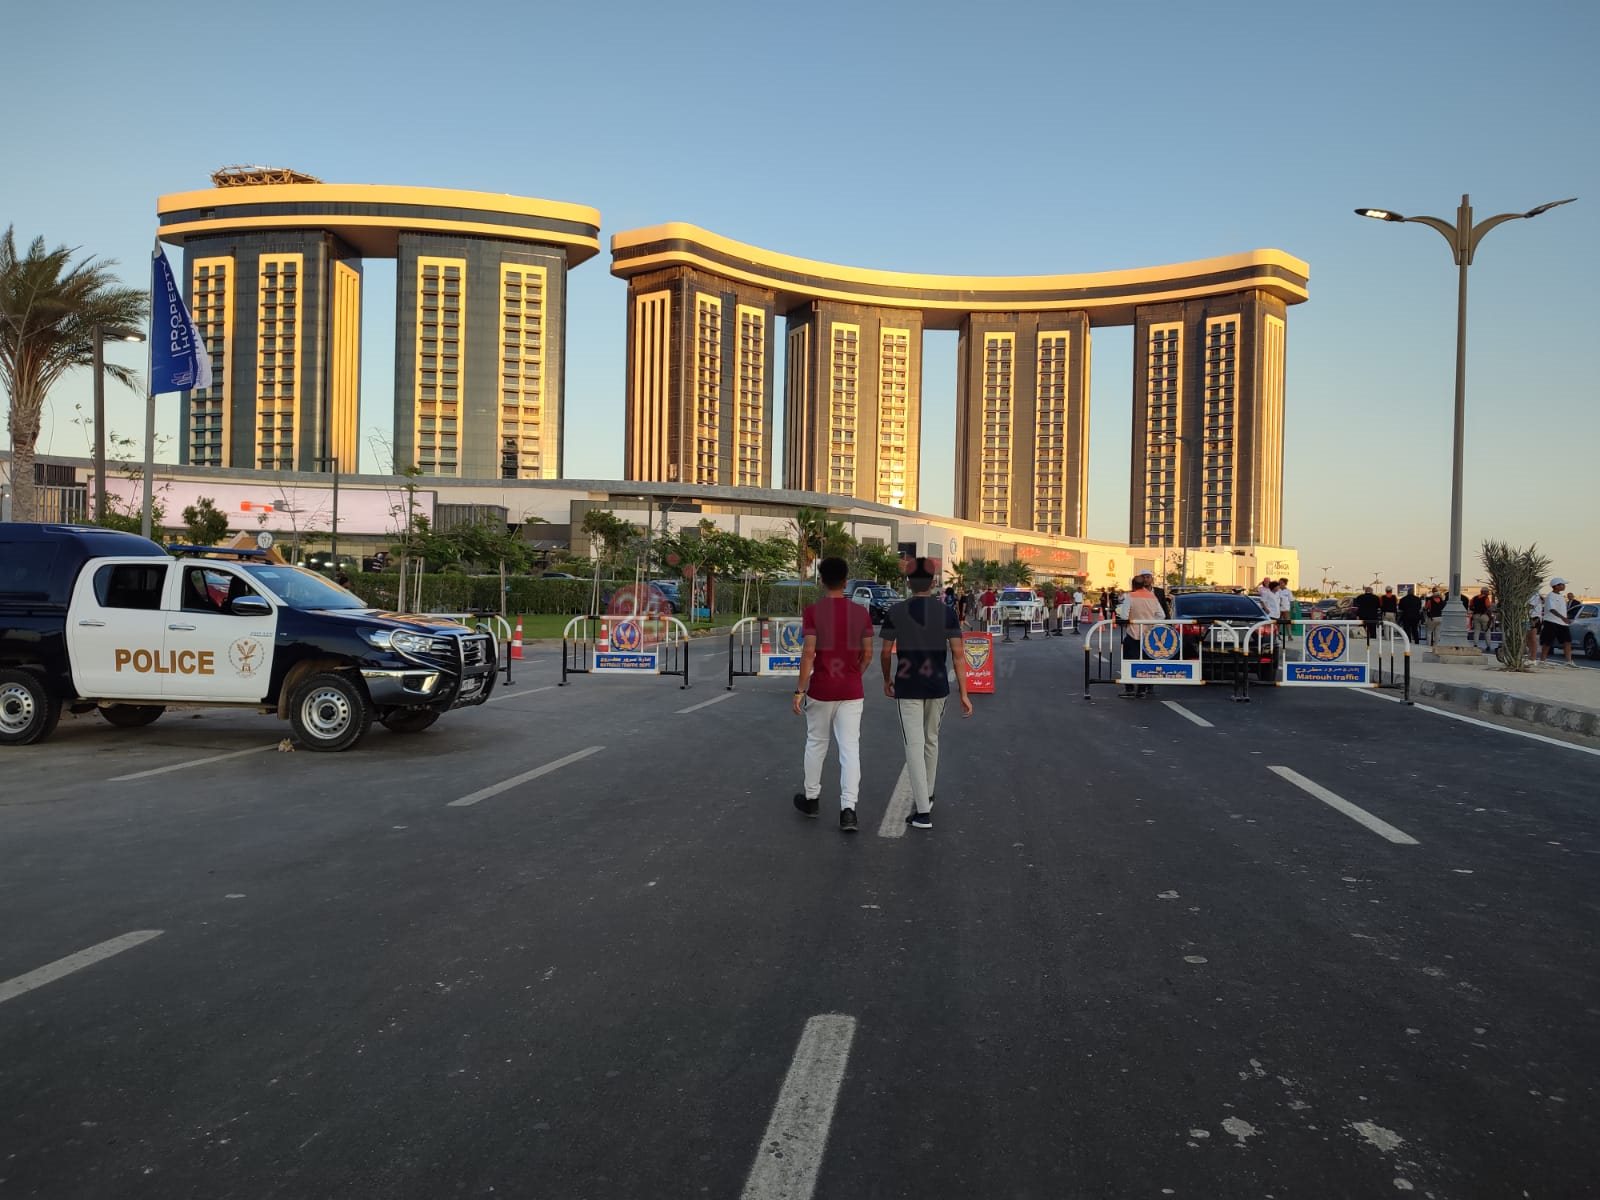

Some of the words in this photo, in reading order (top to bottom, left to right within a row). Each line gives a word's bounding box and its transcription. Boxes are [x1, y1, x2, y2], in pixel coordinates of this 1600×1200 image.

[115, 649, 214, 675] POLICE
[1296, 672, 1332, 681] Matrouh
[1333, 673, 1360, 681] traffic
